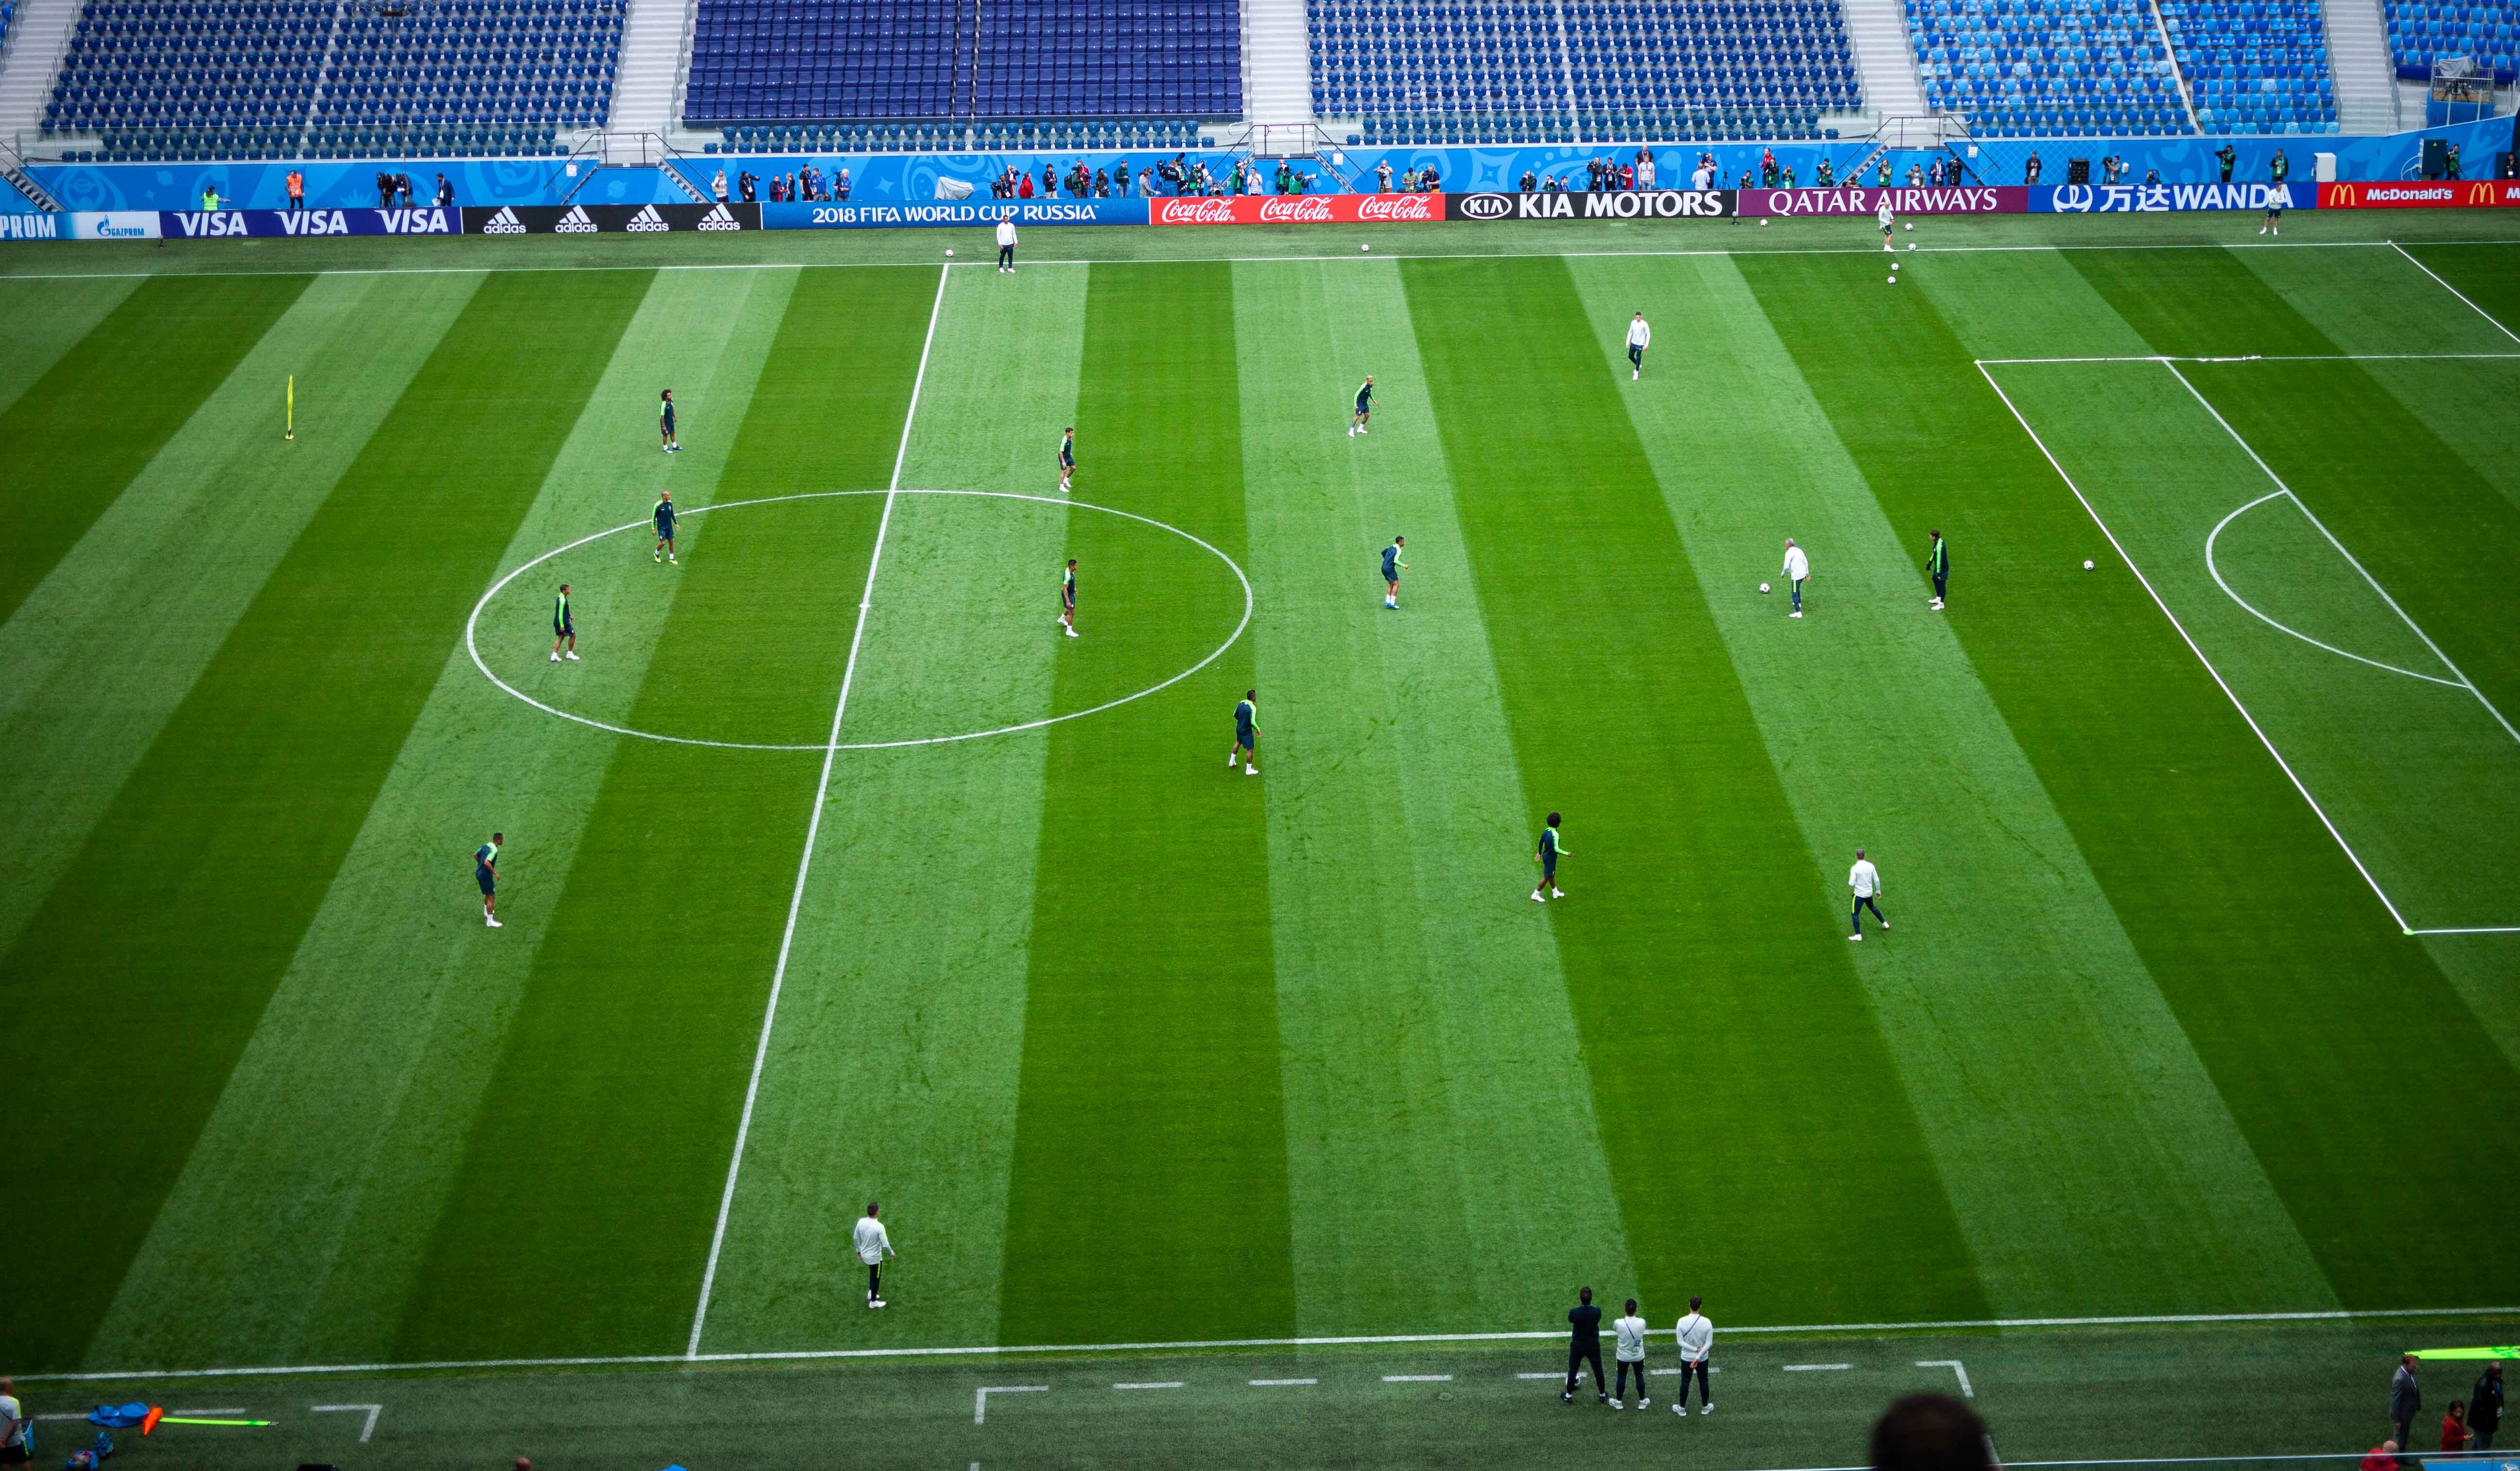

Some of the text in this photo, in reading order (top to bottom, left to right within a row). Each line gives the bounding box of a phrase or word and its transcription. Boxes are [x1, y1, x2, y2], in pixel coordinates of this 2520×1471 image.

[1469, 199, 1503, 213] KIA
[1519, 191, 1723, 218] KIA MOTORS
[1769, 188, 1997, 216] QATAR AIRWAYS
[2100, 184, 2170, 212] 万达
[2173, 184, 2294, 209] WANDA
[2366, 189, 2452, 200] McDonald's
[813, 208, 856, 223] 2018
[860, 208, 901, 222] FIFA
[904, 207, 975, 222] WORLD
[979, 206, 1019, 220] CUP
[1162, 198, 1236, 222] Coca-Cola
[1260, 197, 1334, 221] Coca-Cola
[1358, 195, 1432, 219] Coca-Cola
[111, 228, 144, 236] GAZPROM
[173, 212, 248, 236] VISA
[274, 211, 348, 234] VISA
[375, 209, 449, 233] VISA
[483, 224, 526, 234] adidas
[555, 223, 598, 233] adidas
[626, 222, 669, 232] adidas
[698, 221, 741, 231] adidas
